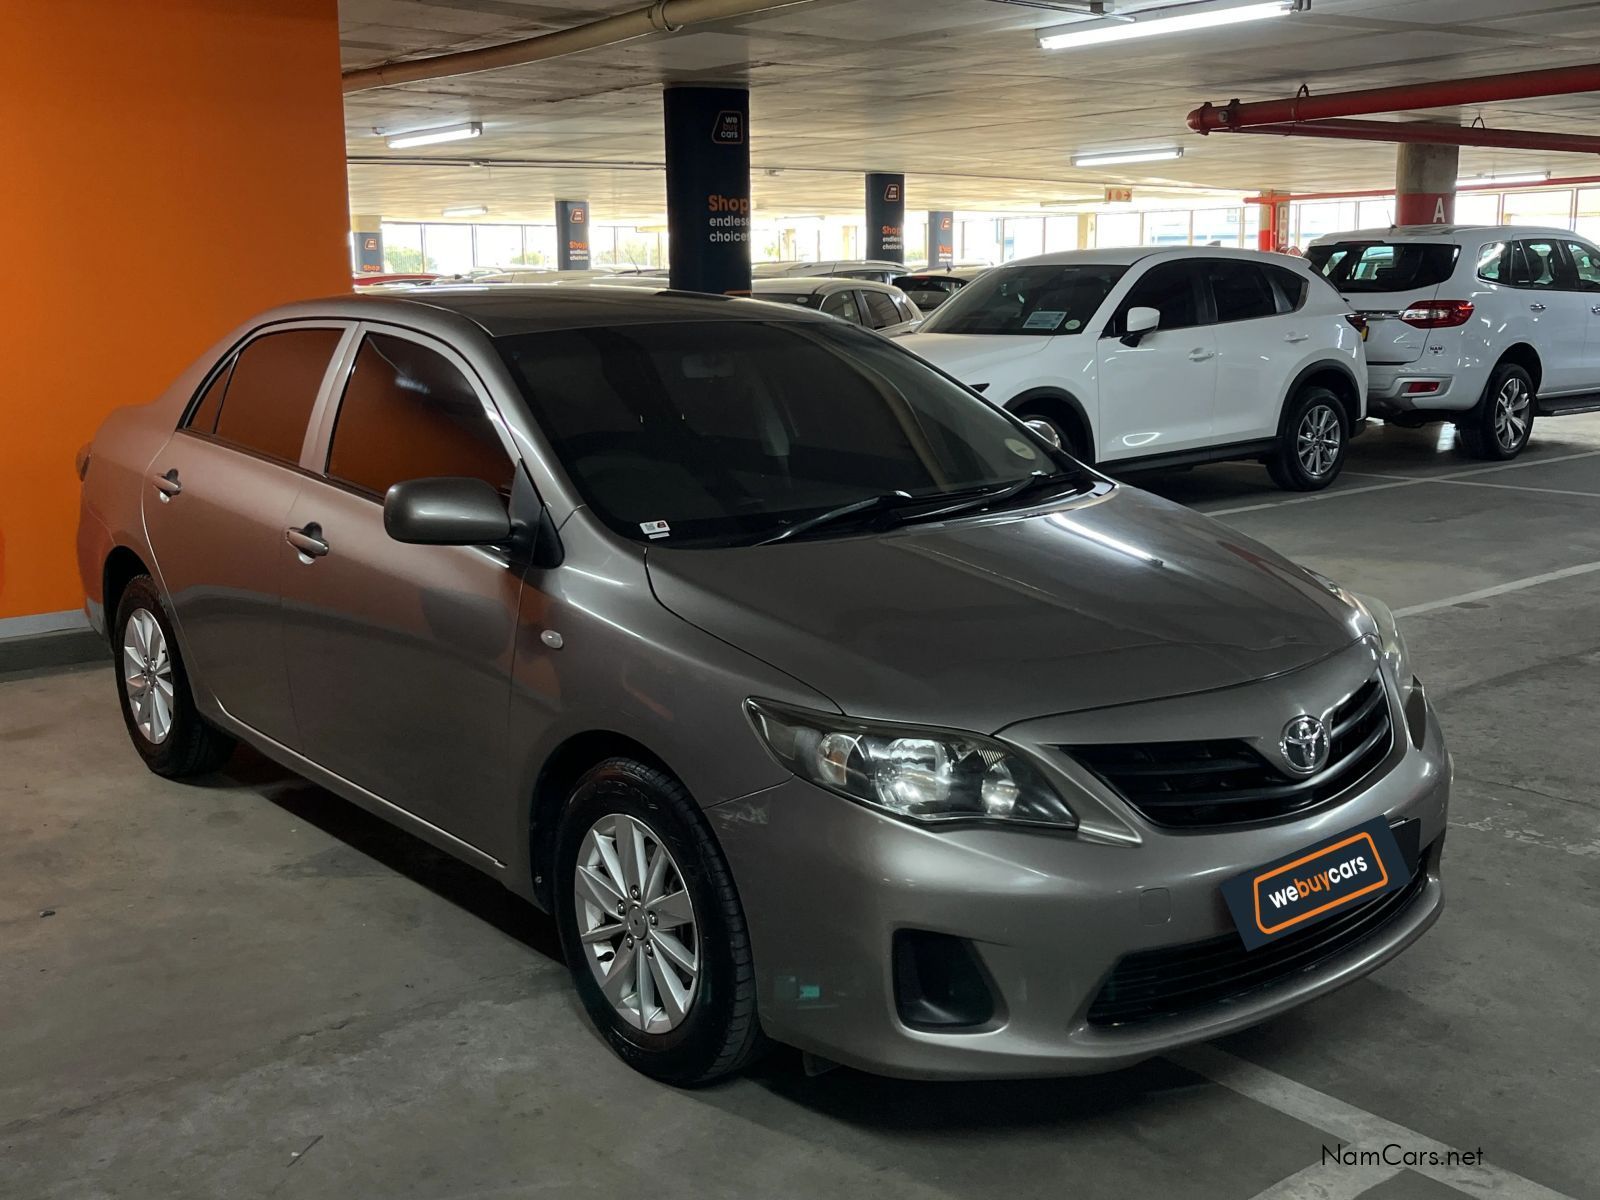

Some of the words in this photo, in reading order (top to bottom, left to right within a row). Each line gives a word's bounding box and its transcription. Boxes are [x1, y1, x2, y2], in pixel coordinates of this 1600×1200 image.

[708, 194, 749, 215] Shop
[1432, 197, 1446, 224] A
[709, 215, 751, 227] endless
[882, 224, 902, 236] Shop
[1268, 855, 1368, 909] webuycars
